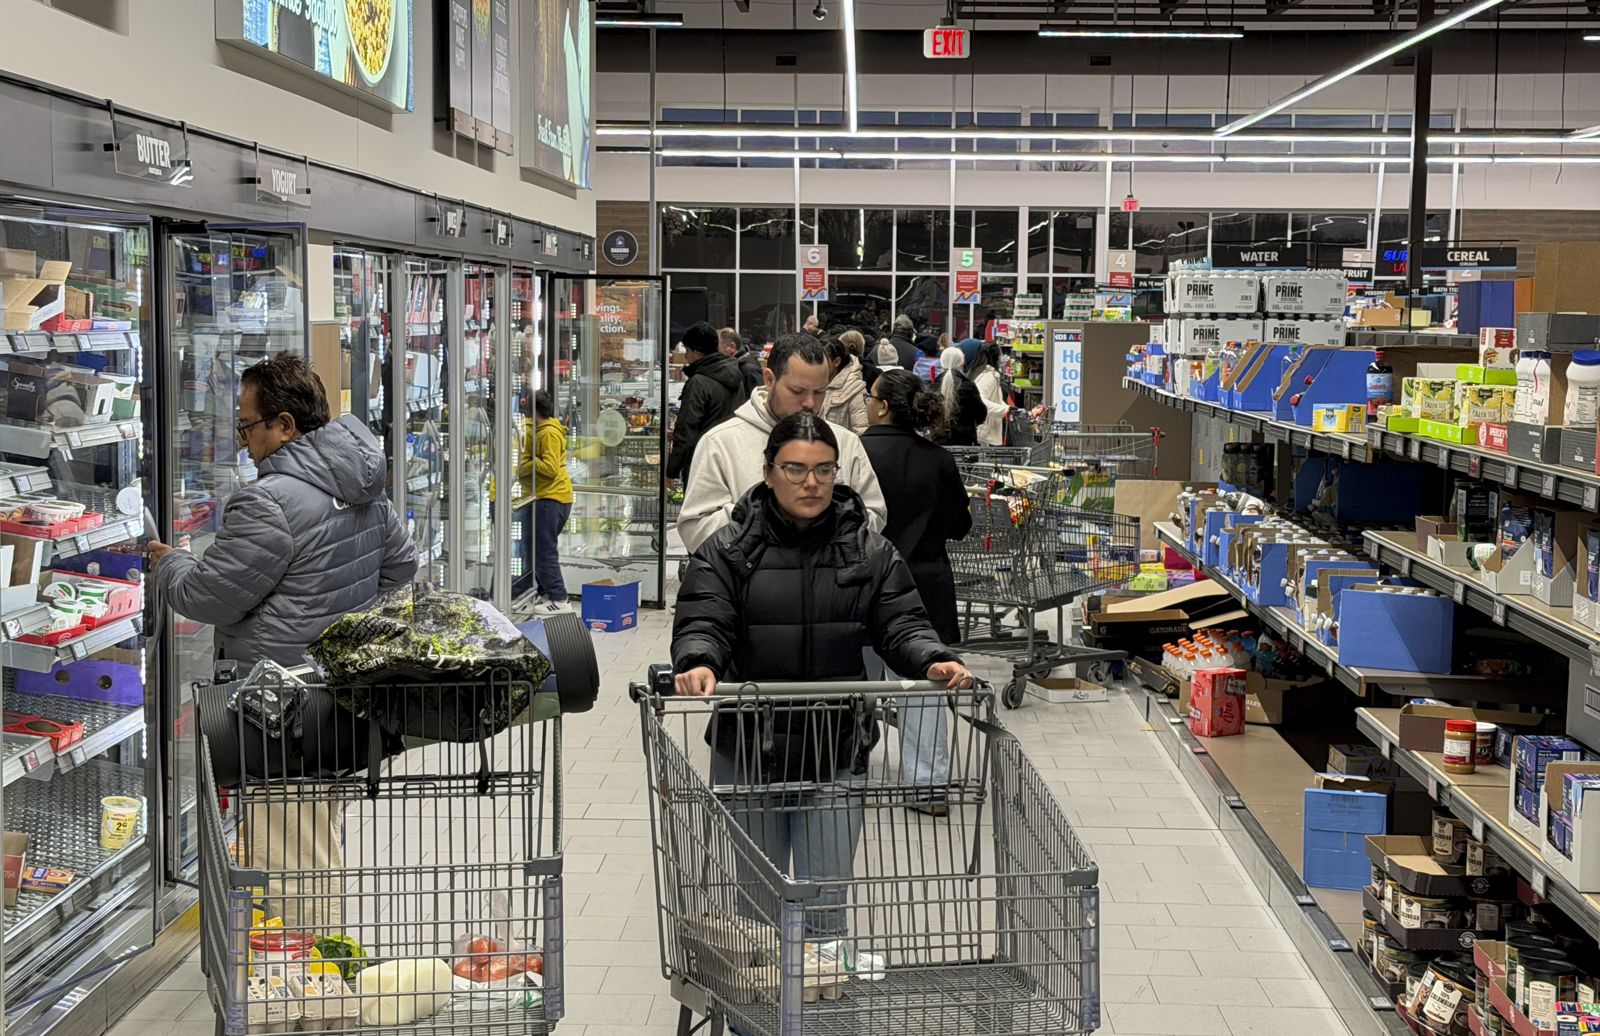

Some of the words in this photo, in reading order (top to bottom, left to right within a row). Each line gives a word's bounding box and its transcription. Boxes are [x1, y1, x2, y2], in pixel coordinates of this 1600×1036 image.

[932, 31, 965, 56] EXIT
[136, 133, 171, 168] BUTTER
[271, 168, 297, 196] YOGURT
[807, 247, 821, 264] 6
[961, 250, 975, 268] 5
[1115, 253, 1127, 268] 4
[1240, 251, 1279, 262] WATER
[1447, 251, 1490, 262] CEREAL
[1343, 269, 1369, 278] FRUIT
[1186, 283, 1214, 296] PRIME
[1275, 285, 1303, 298] PRIME
[1193, 328, 1220, 340] PRIME
[1273, 326, 1300, 339] PRIME
[1061, 367, 1079, 380] to
[1061, 399, 1078, 413] to
[1149, 626, 1187, 634] GATORADE
[355, 656, 385, 671] Giant
